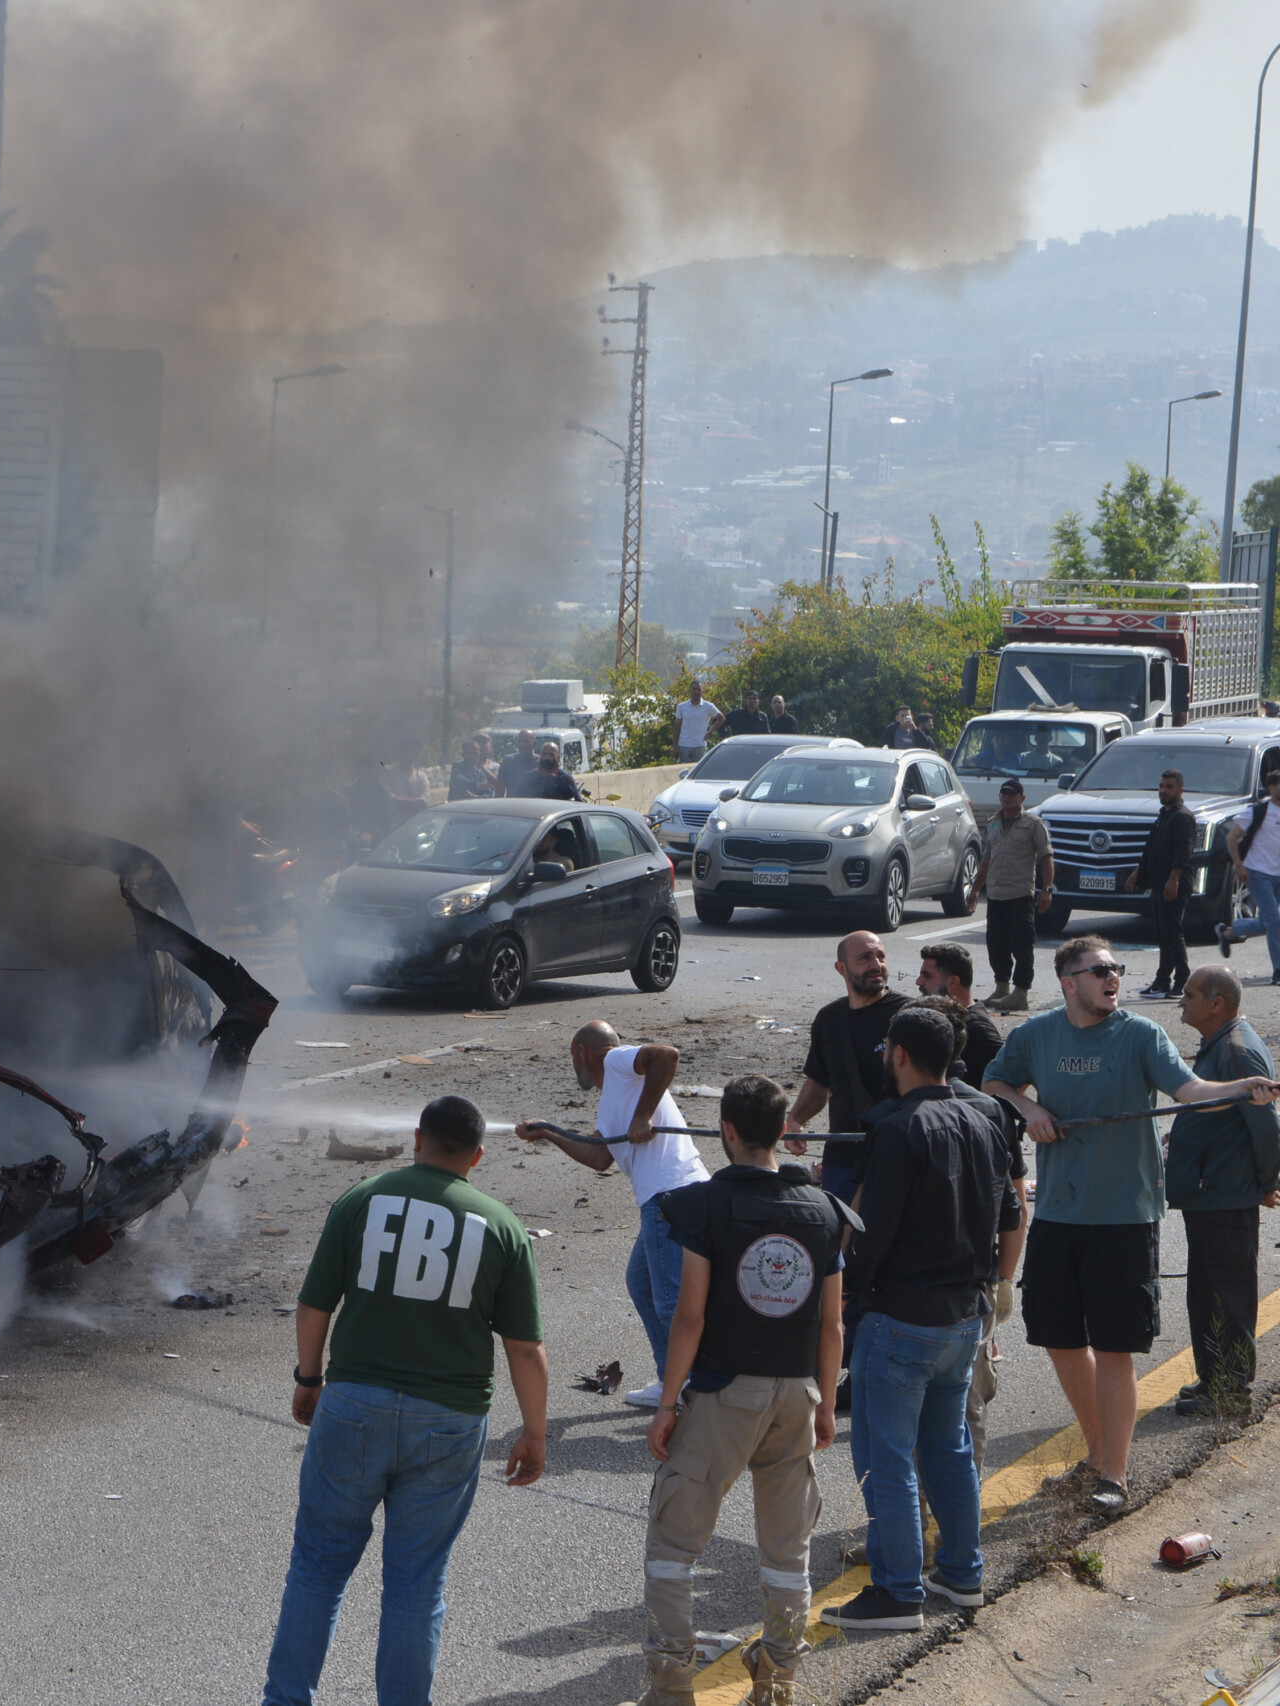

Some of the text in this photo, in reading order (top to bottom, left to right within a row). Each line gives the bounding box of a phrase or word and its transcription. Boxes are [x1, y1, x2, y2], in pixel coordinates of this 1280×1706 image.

[753, 873, 788, 884] B652957
[1080, 877, 1115, 889] G209915
[357, 1194, 488, 1309] FBI
